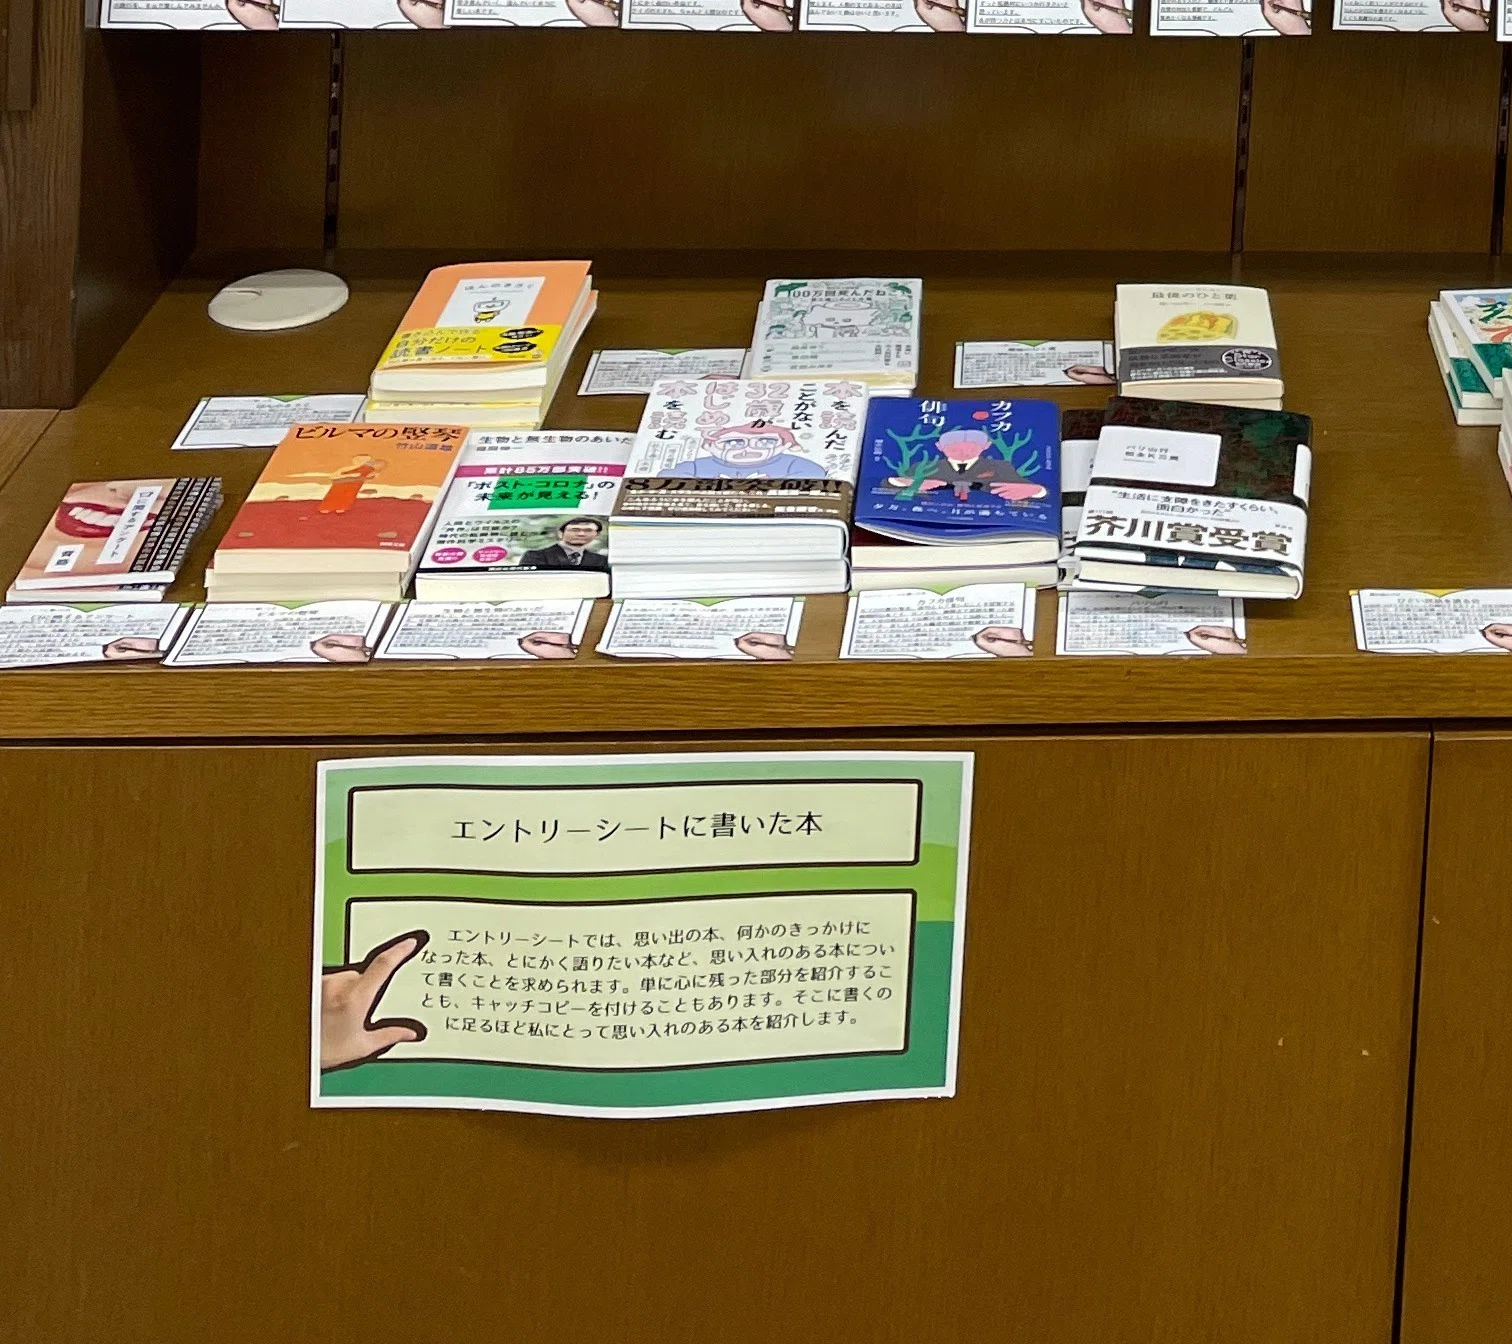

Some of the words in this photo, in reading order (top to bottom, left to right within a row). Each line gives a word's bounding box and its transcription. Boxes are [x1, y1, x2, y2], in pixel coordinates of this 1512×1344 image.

[919, 400, 947, 427] 俳句
[990, 400, 1014, 433] カフカ
[295, 425, 461, 443] ビルマの竪琴
[479, 434, 633, 447] 生物と無生物のあいだ
[1085, 514, 1292, 555] 芥川賞受賞
[451, 809, 823, 844] エントリーシートに書いた本
